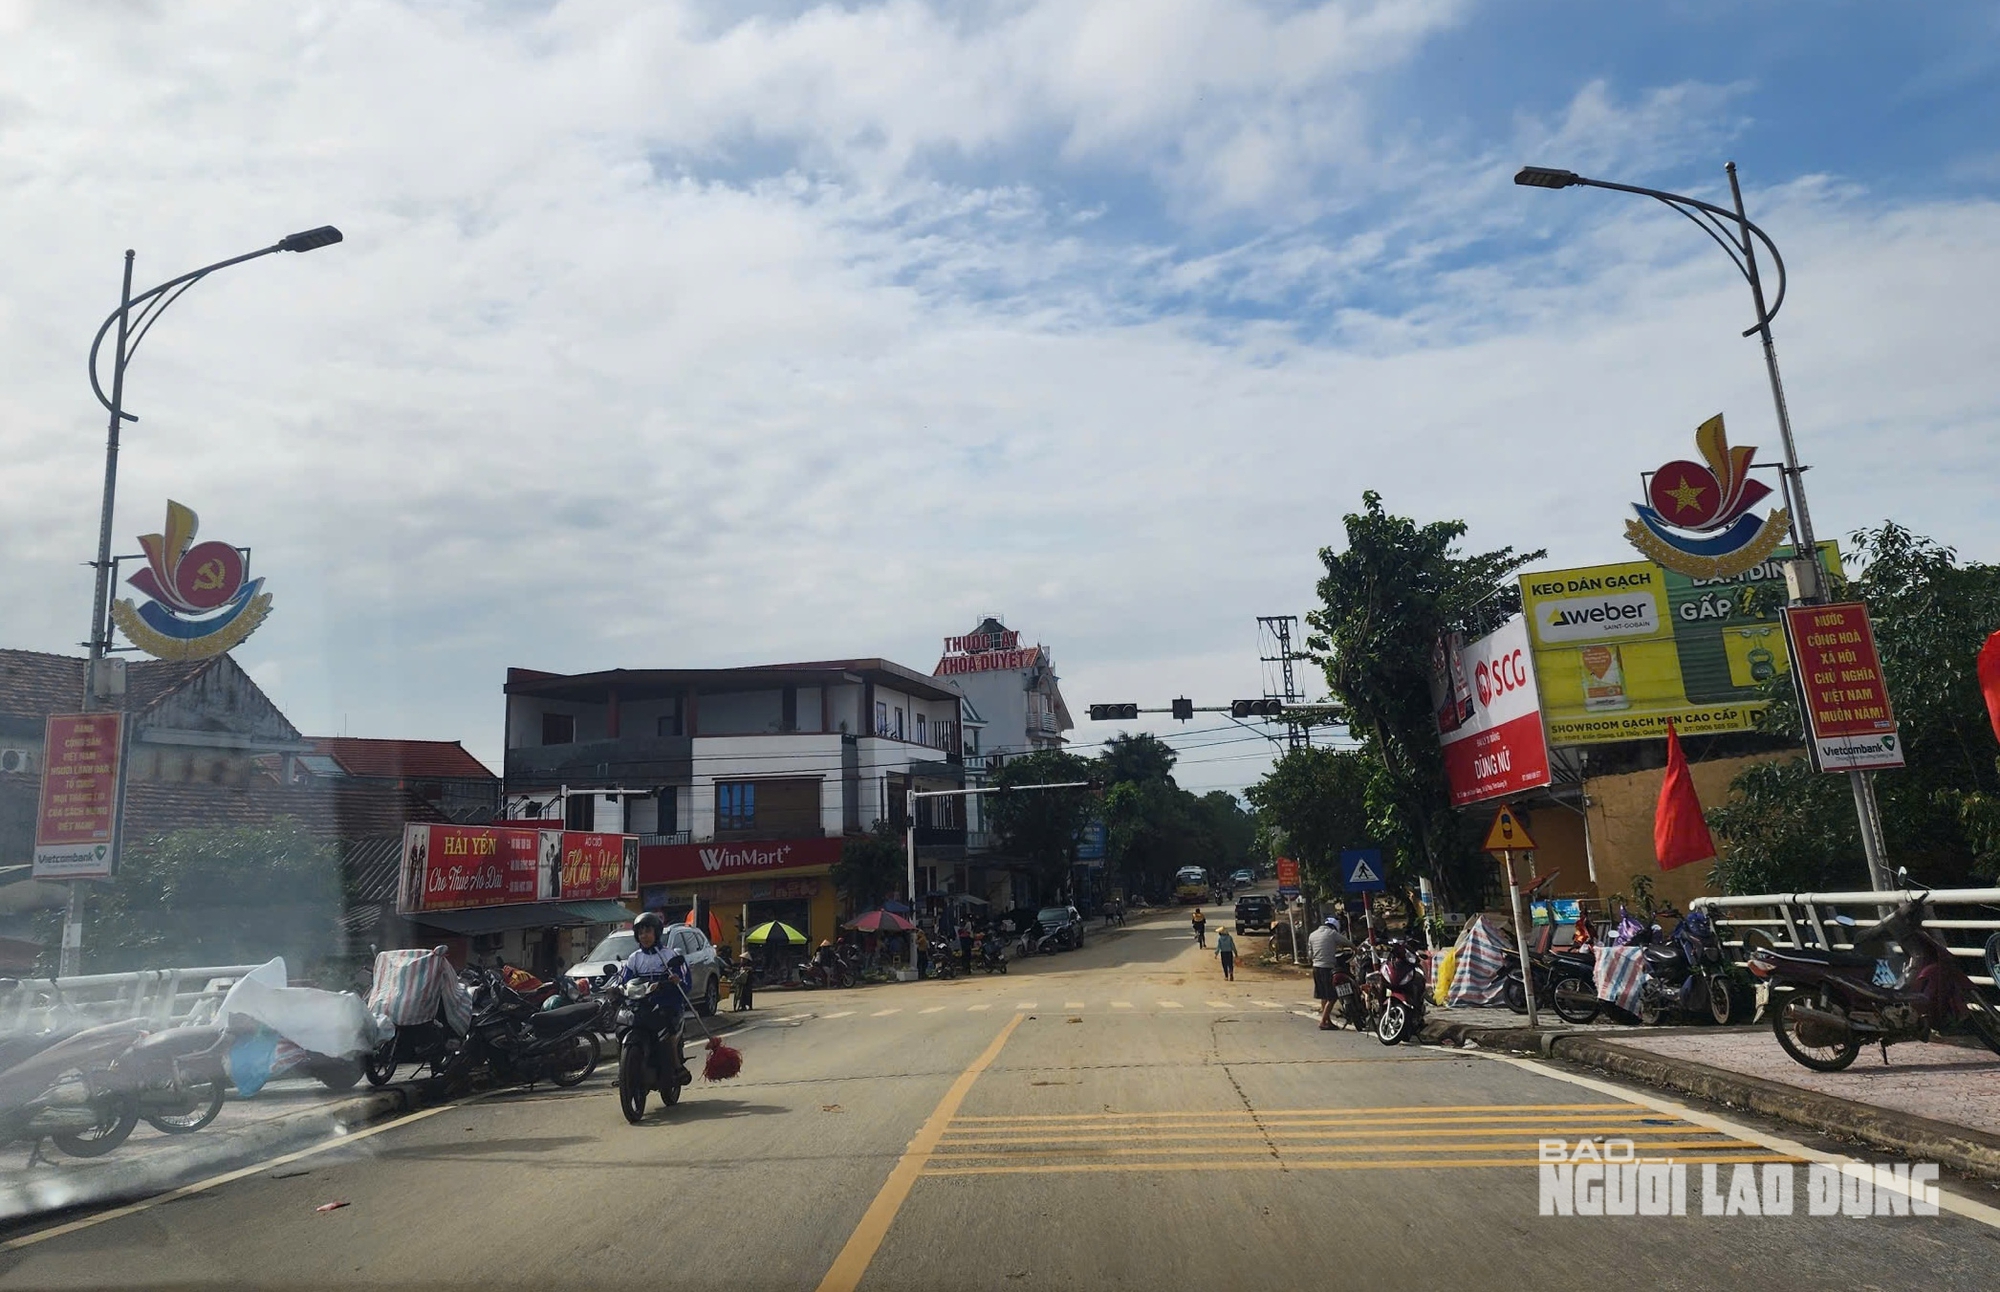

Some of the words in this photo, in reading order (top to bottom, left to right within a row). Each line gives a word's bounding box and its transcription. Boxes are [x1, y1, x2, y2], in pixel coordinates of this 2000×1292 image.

[1531, 582, 1564, 596] KEO
[1568, 576, 1601, 592] DÁN
[1605, 572, 1651, 590] GẠCH
[1568, 602, 1647, 625] weber
[1807, 632, 1837, 648] CỘNG
[1820, 650, 1836, 665] XÃ
[1837, 648, 1857, 665] HỘI
[1492, 648, 1526, 697] SCG
[1821, 688, 1844, 705] VIỆT
[1847, 688, 1873, 702] NAM
[1551, 720, 1619, 734] SHOWROOM
[1622, 717, 1654, 729] GẠCH
[1685, 713, 1710, 723] CAO
[1713, 708, 1738, 720] CẤP
[1819, 707, 1852, 723] MUÔN
[1823, 742, 1884, 756] Vietcombank
[444, 830, 468, 855] HẢI
[472, 830, 497, 855] YẾN
[38, 852, 93, 864] Vietcombank
[699, 845, 791, 871] WinMart+
[429, 866, 446, 892] Cho
